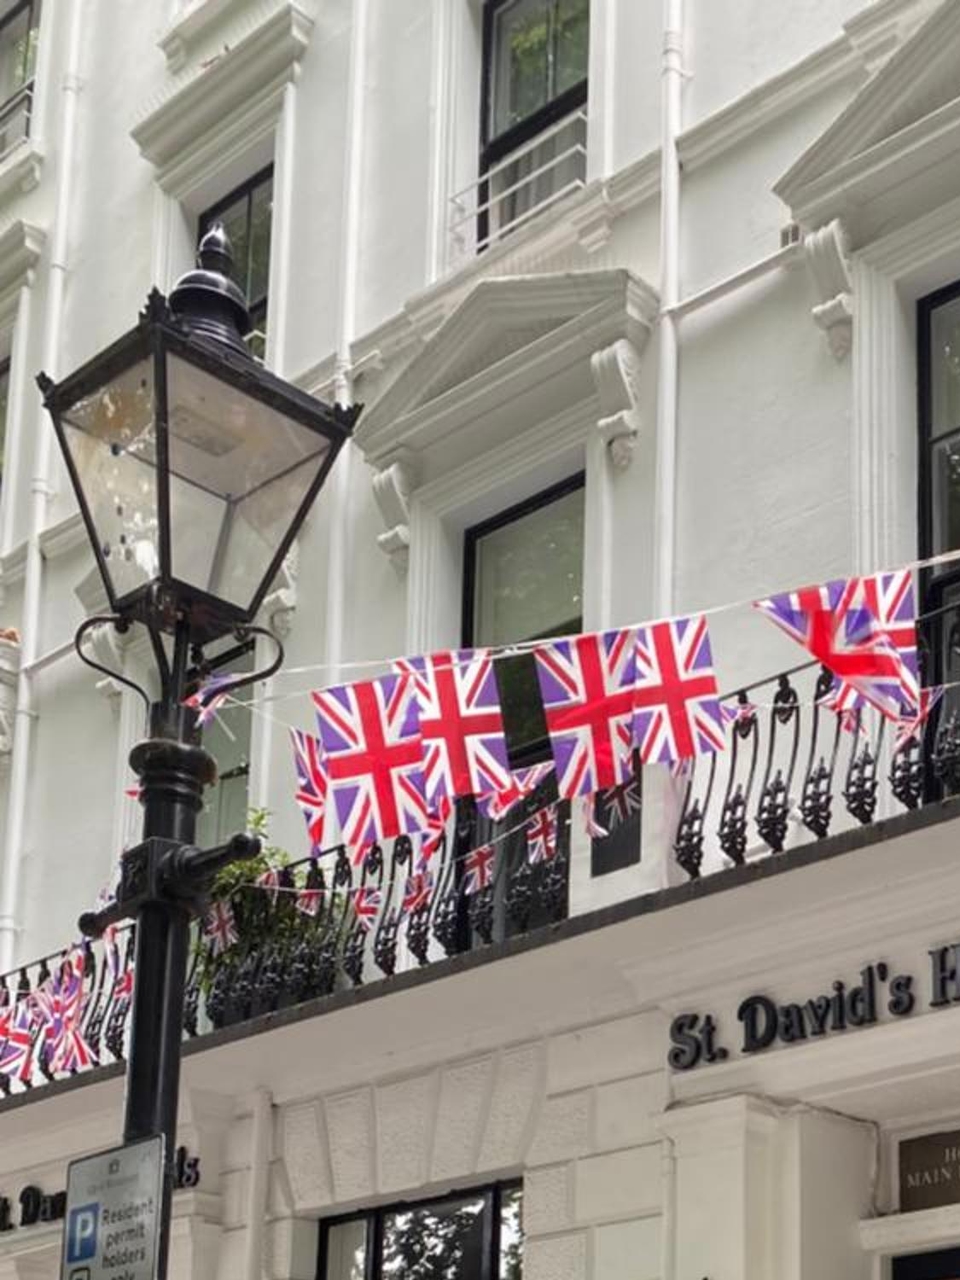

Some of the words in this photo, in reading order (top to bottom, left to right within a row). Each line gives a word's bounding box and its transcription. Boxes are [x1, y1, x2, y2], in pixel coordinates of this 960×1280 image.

[667, 1013, 728, 1070] St.
[737, 961, 914, 1053] David's
[907, 1166, 952, 1188] MAIN
[101, 1197, 154, 1227] Resident
[74, 1210, 94, 1257] P
[105, 1221, 145, 1249] permit
[101, 1246, 145, 1269] holders
